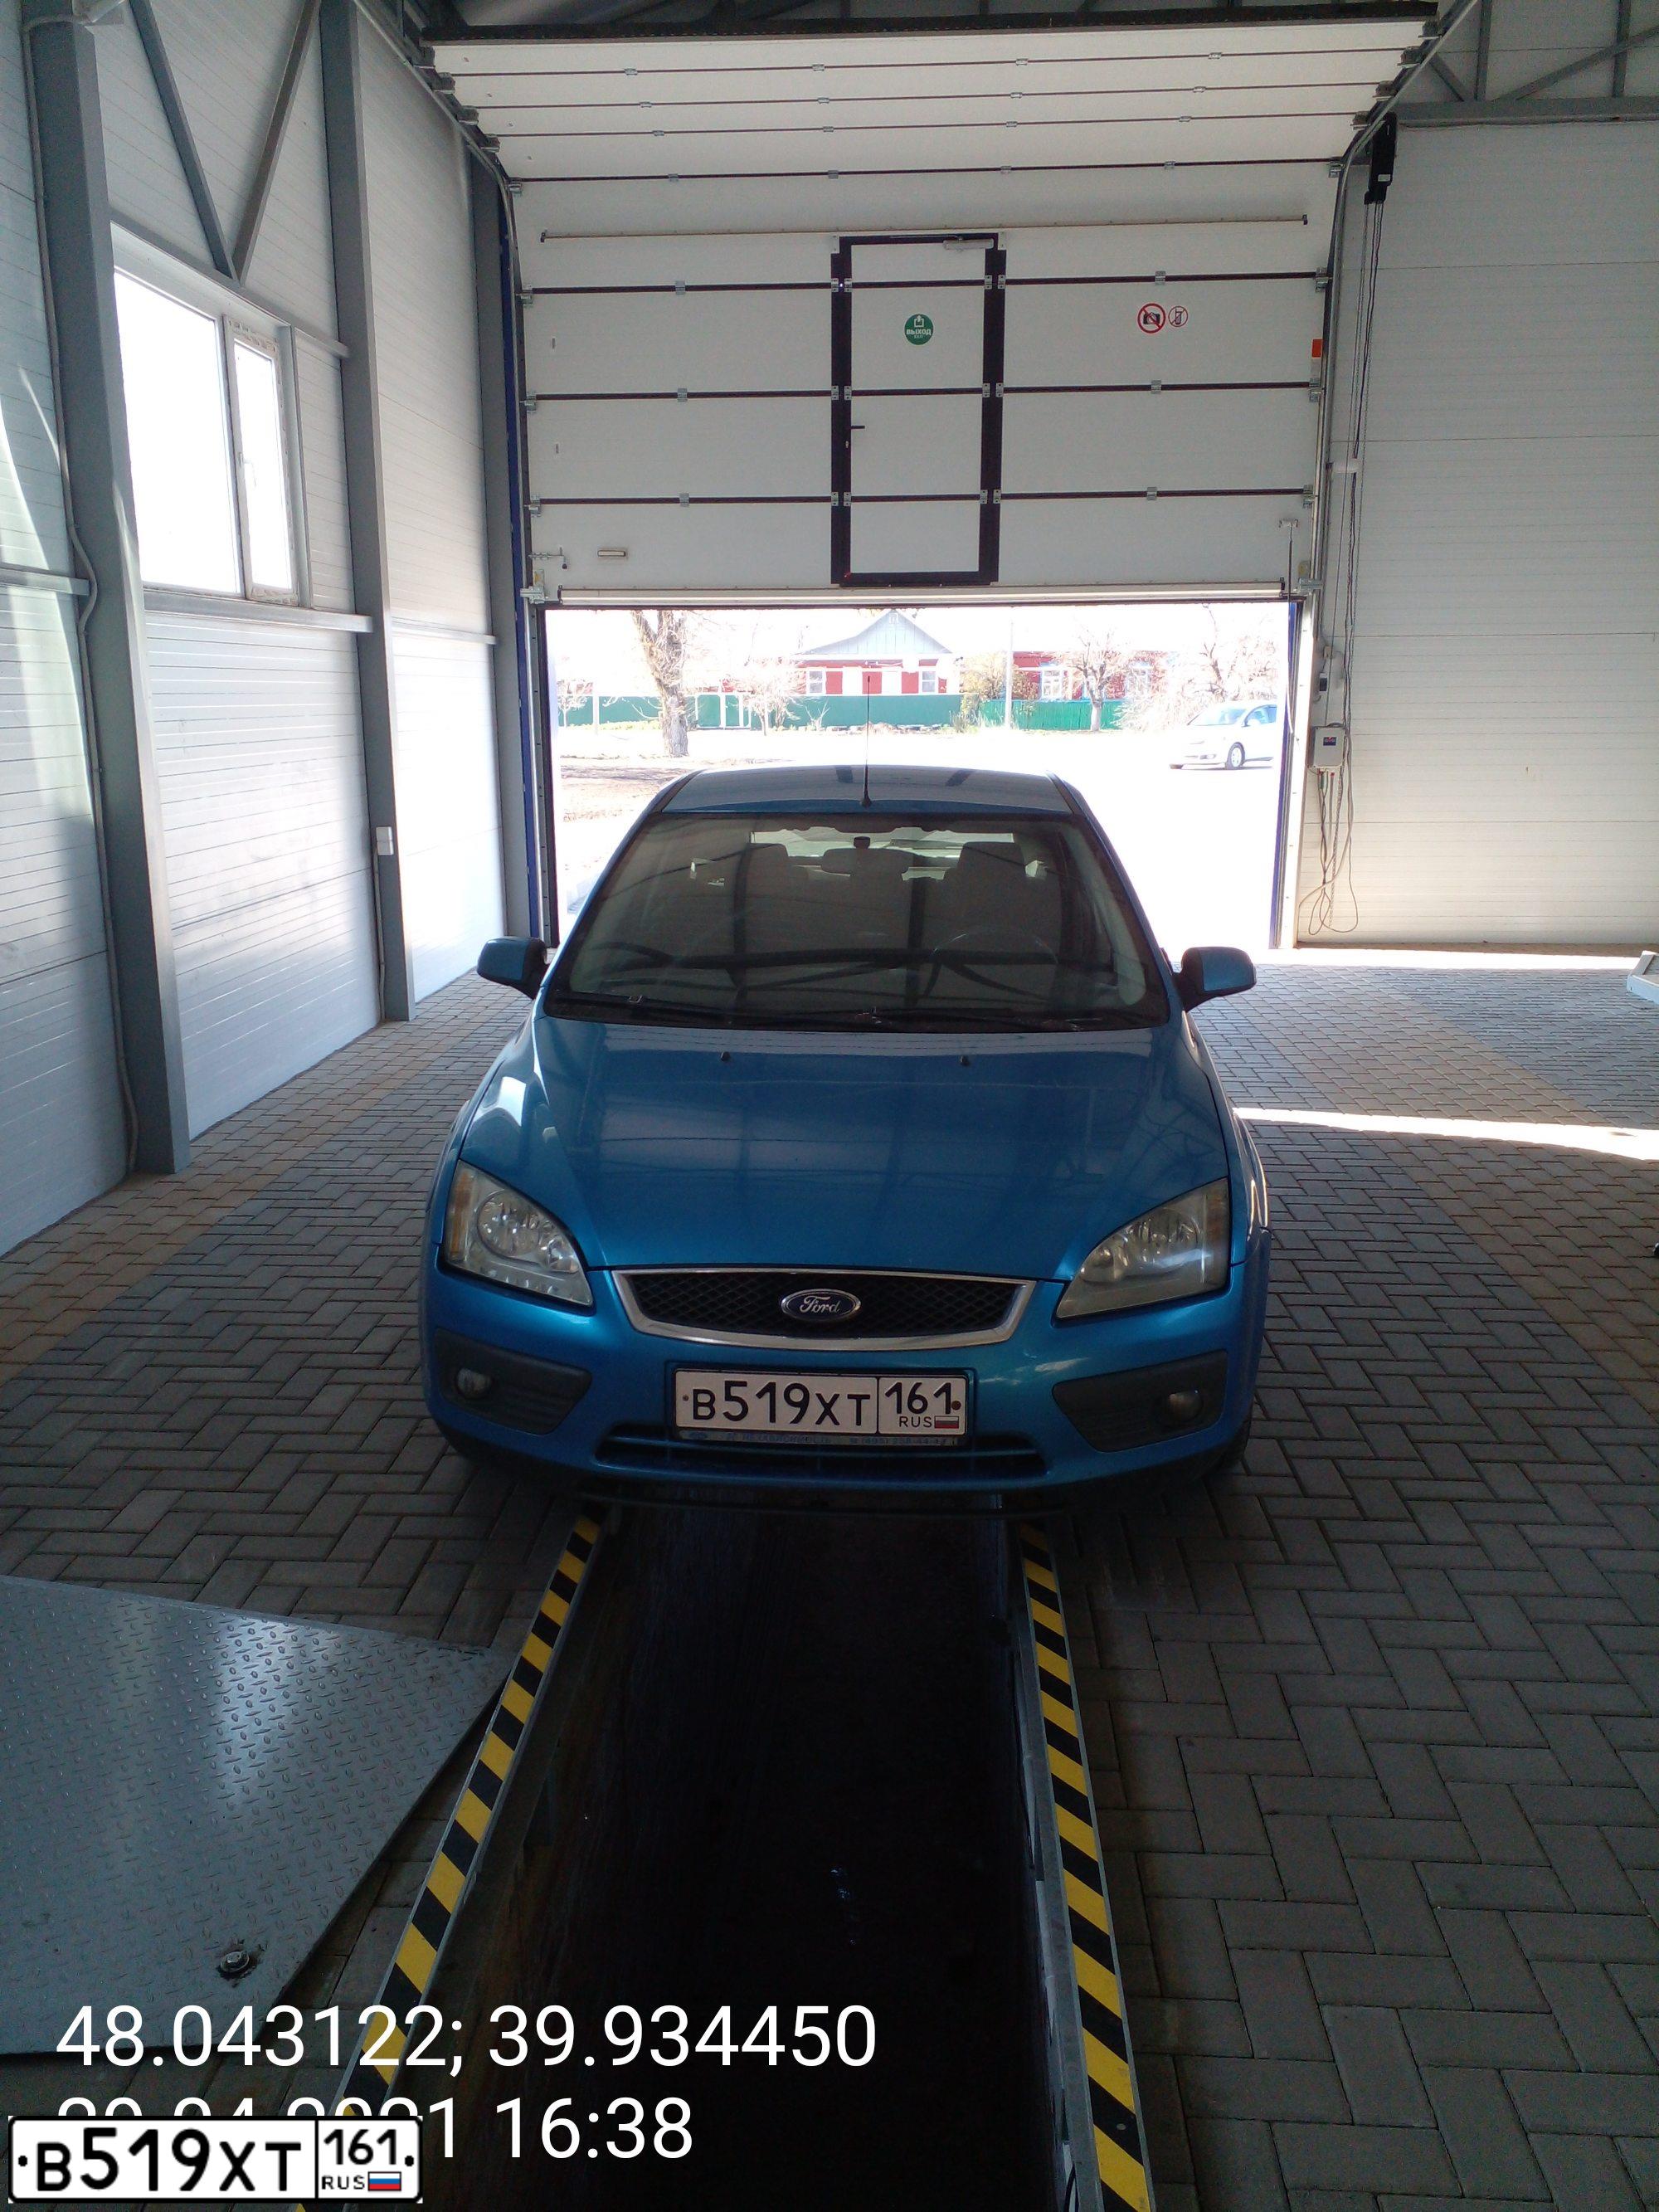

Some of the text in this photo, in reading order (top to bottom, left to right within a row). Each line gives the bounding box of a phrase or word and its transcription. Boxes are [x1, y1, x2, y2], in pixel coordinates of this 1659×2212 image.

[799, 1294, 841, 1313] Ford
[884, 1381, 952, 1415] 161
[898, 1415, 933, 1429] RUS
